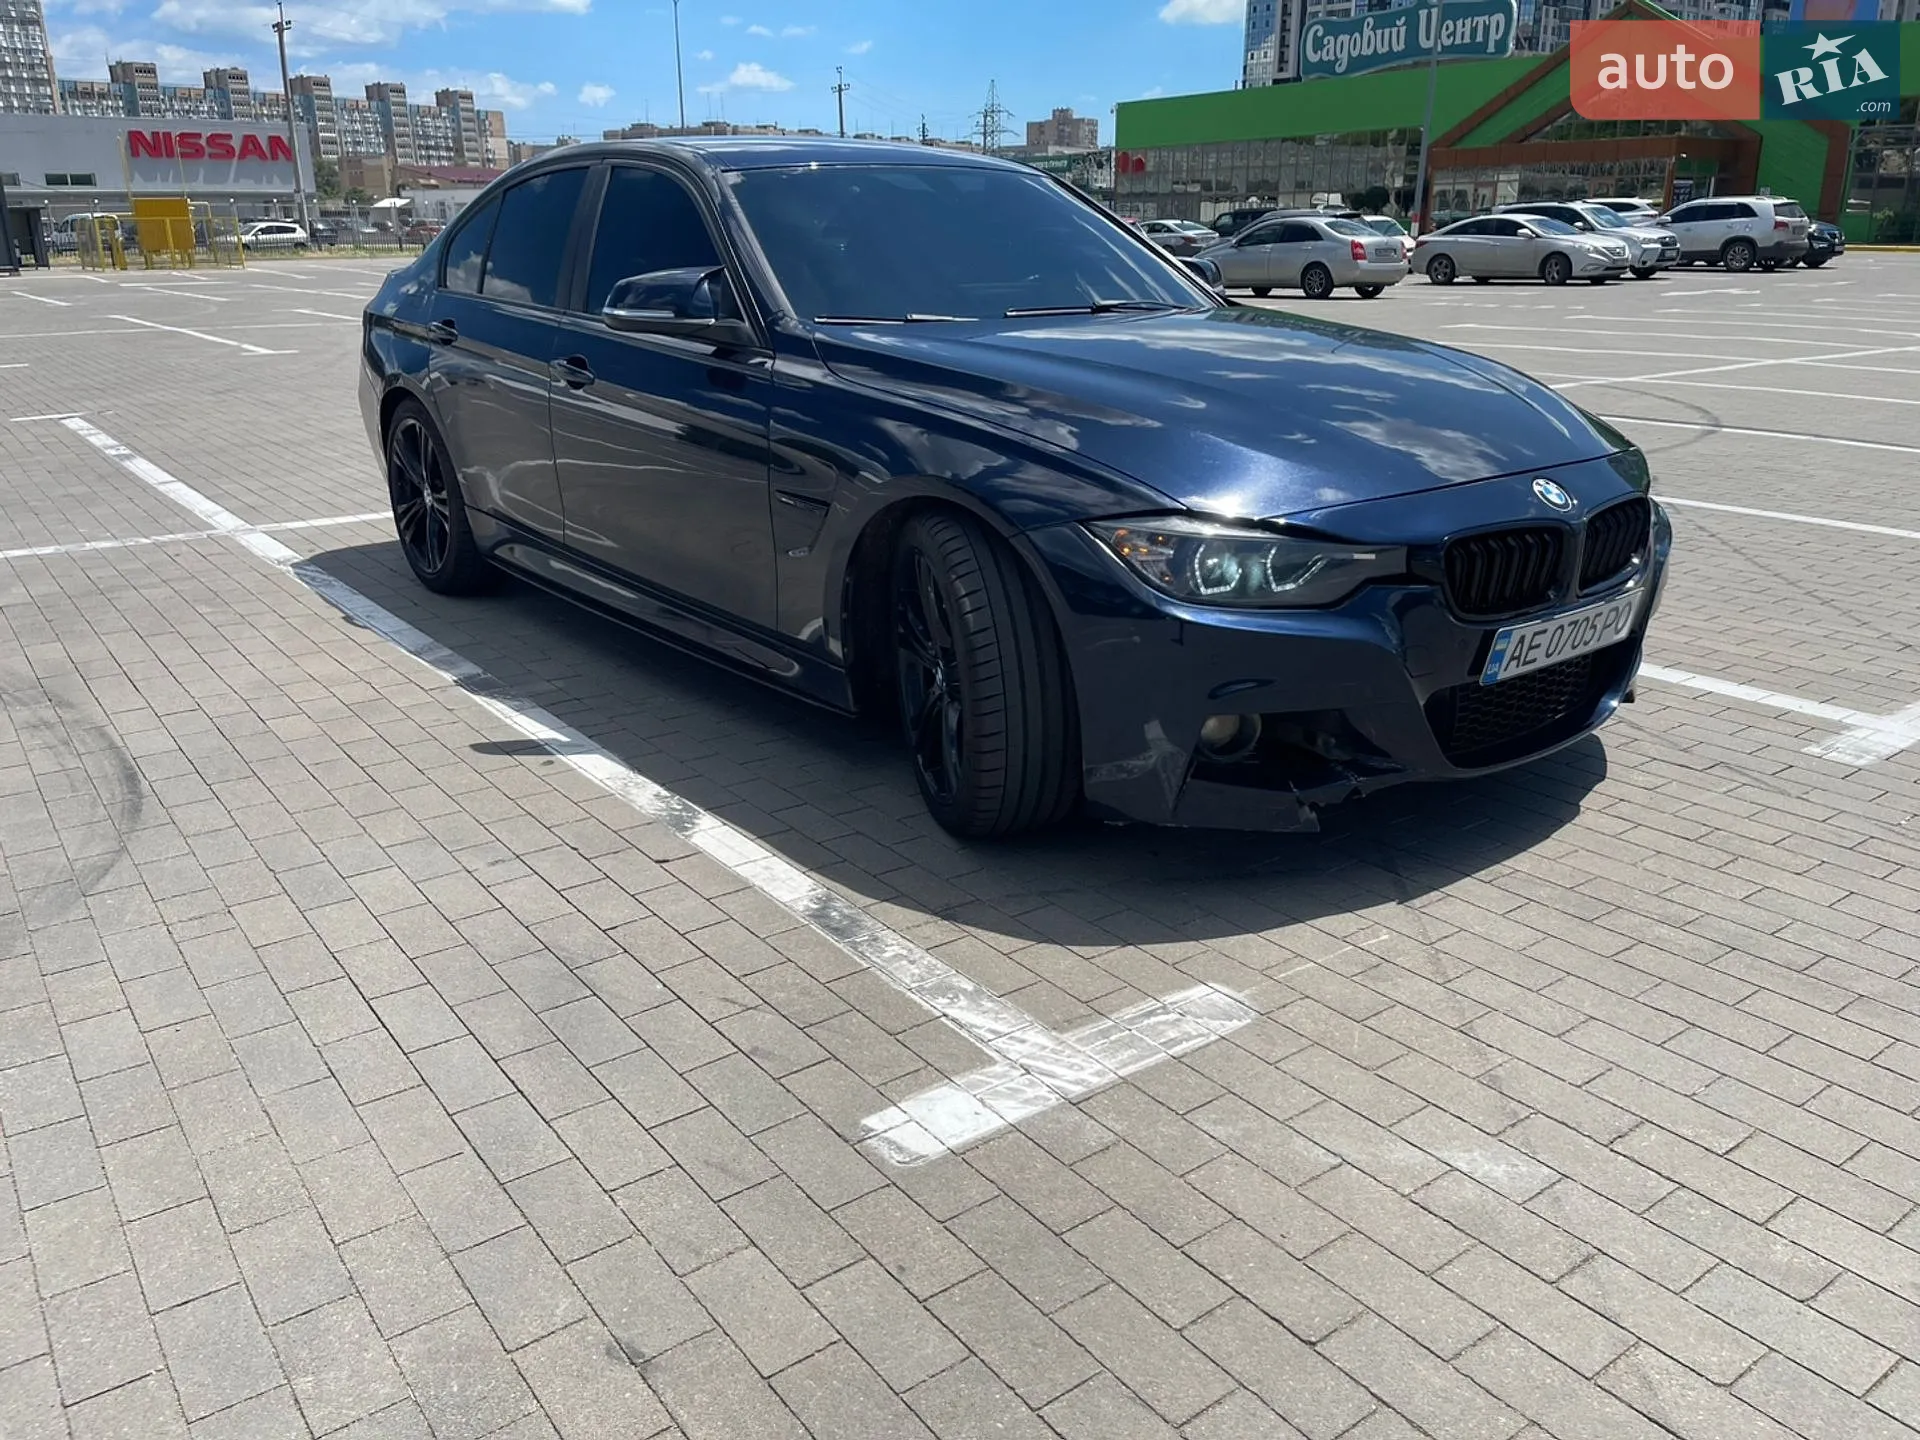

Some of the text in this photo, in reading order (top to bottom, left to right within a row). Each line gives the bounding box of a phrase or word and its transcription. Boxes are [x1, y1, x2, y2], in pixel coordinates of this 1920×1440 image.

[1305, 8, 1505, 73] Садовий Центр
[127, 129, 294, 161] NISSAN
